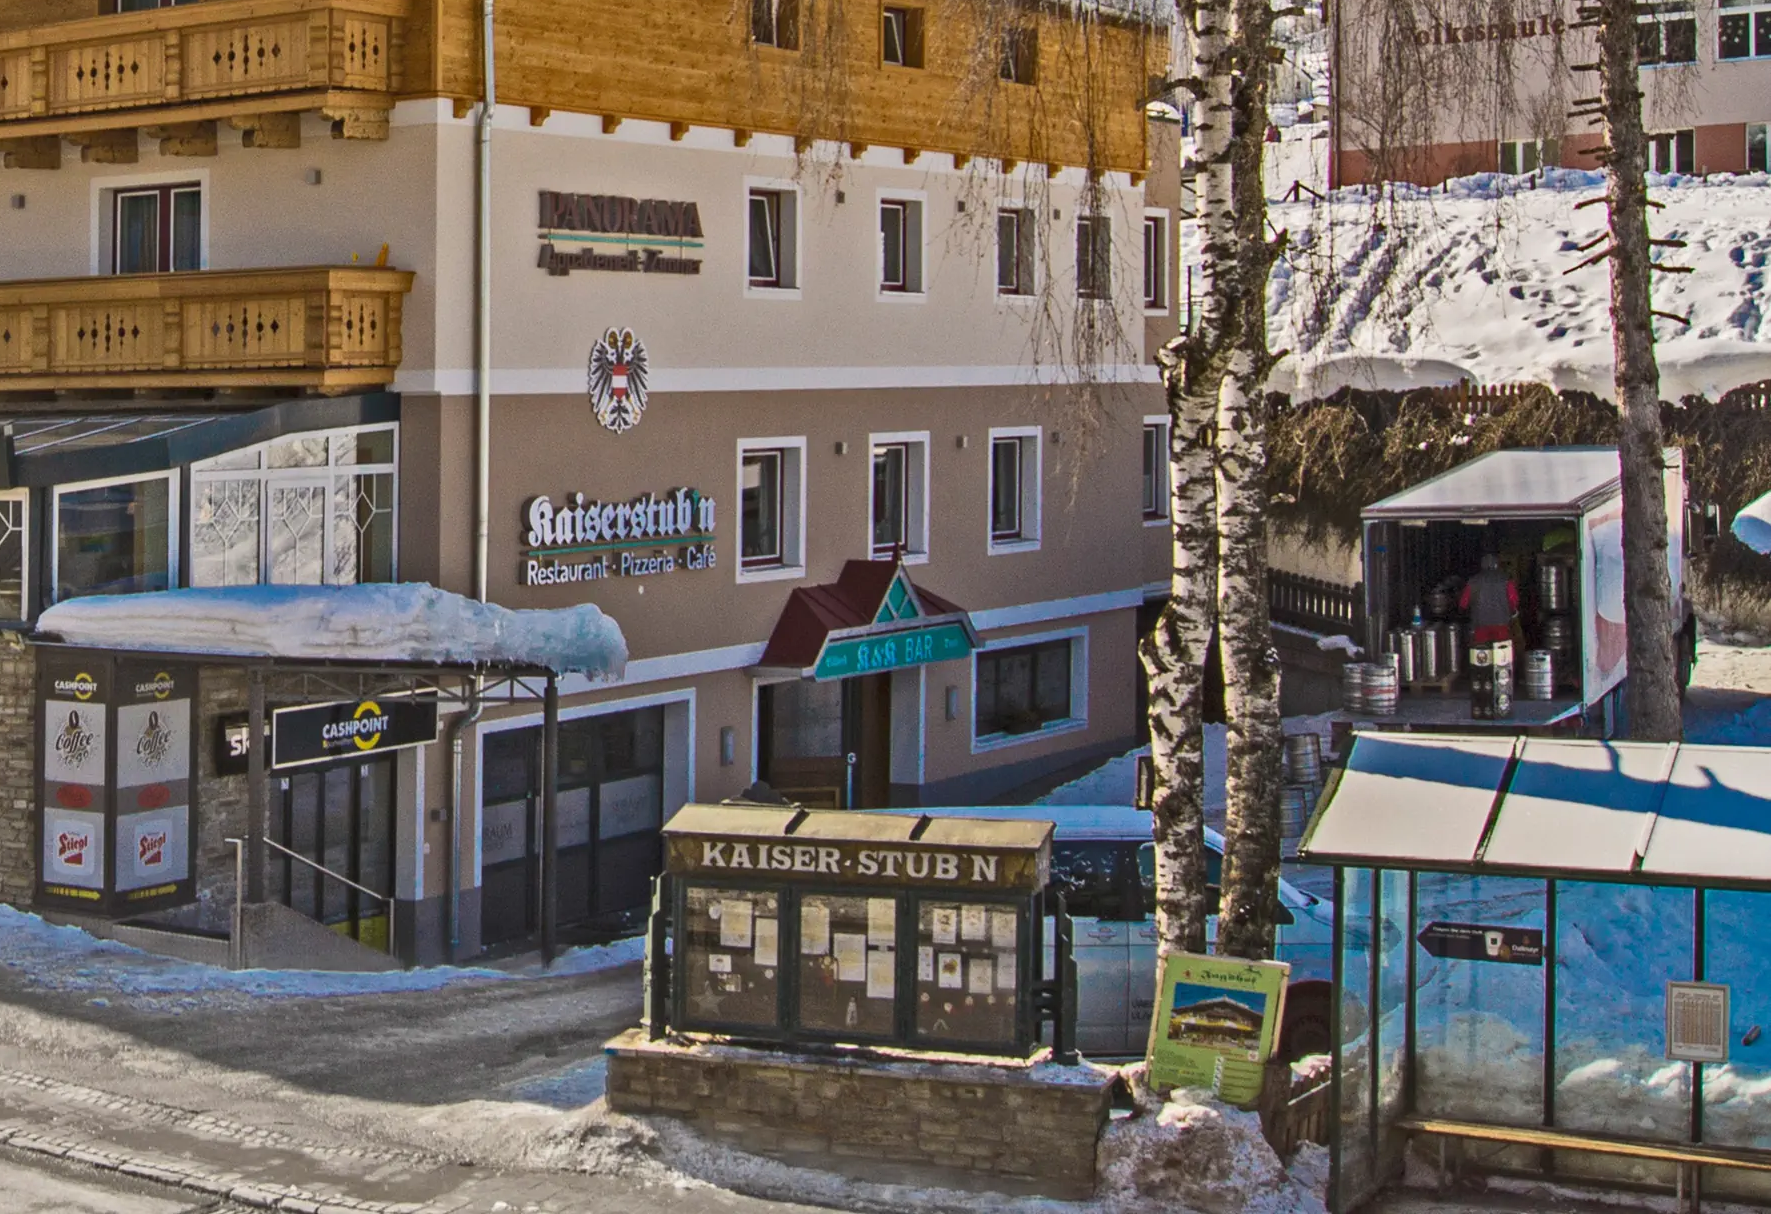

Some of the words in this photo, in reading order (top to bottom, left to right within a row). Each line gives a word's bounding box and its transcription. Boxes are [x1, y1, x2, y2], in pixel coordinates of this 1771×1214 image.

[1411, 14, 1565, 46] olksschule
[538, 191, 704, 238] PANORAMA
[527, 556, 609, 586] Restaurant
[620, 549, 675, 577] Pizzeria
[686, 544, 717, 571] Café
[905, 634, 934, 663] BAR
[54, 680, 98, 693] CASHPOINT
[135, 679, 175, 693] CASHPOINT
[322, 715, 389, 739] CASHPOINT
[55, 730, 94, 754] Coffee
[136, 730, 172, 755] Coffee
[58, 832, 88, 857] Stiegl
[139, 832, 166, 860] Stiegl
